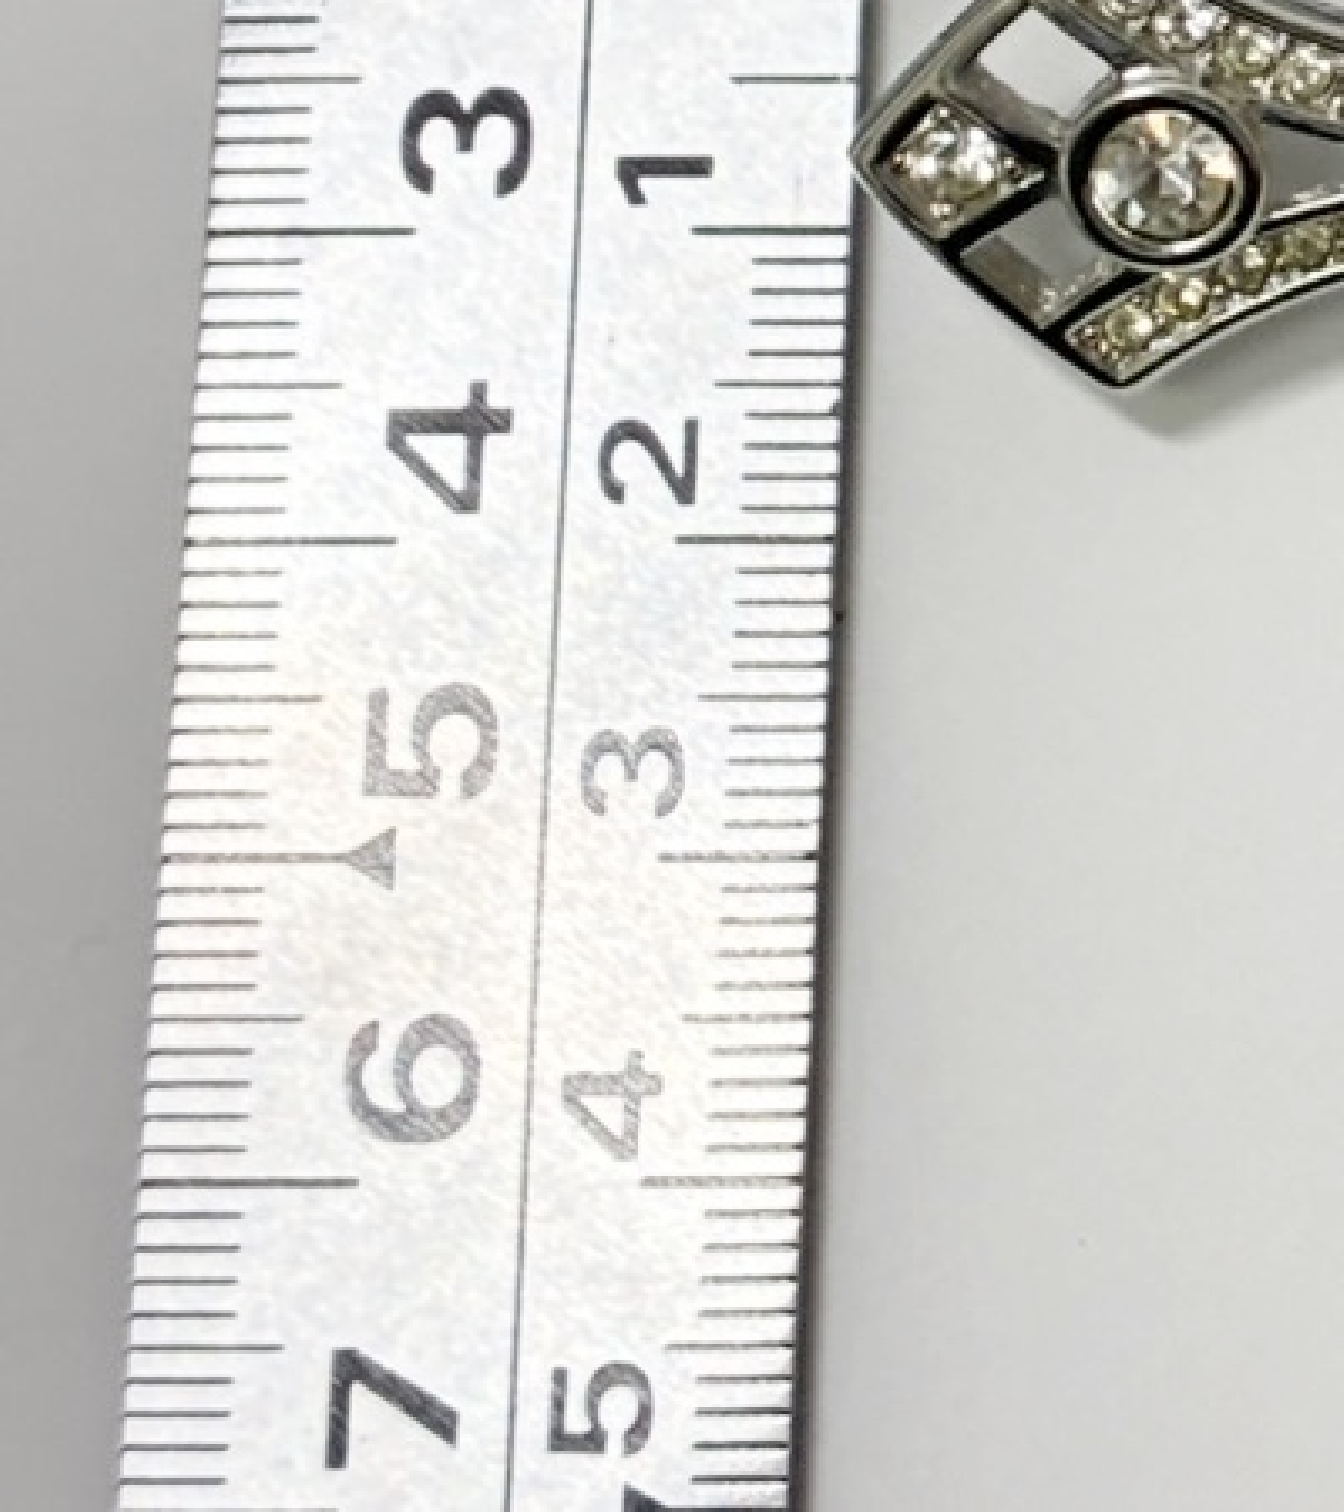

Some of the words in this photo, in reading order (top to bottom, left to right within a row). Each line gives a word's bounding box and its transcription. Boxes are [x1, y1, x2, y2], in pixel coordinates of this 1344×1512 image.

[400, 87, 533, 198] 3
[614, 155, 714, 205] 1
[386, 382, 514, 514] 4
[601, 418, 698, 505] 2
[361, 682, 498, 799] 5
[580, 728, 684, 817] 3
[345, 1013, 481, 1144] 6
[562, 1048, 664, 1161] 4
[325, 1347, 460, 1470] 7
[547, 1361, 655, 1458] 5
